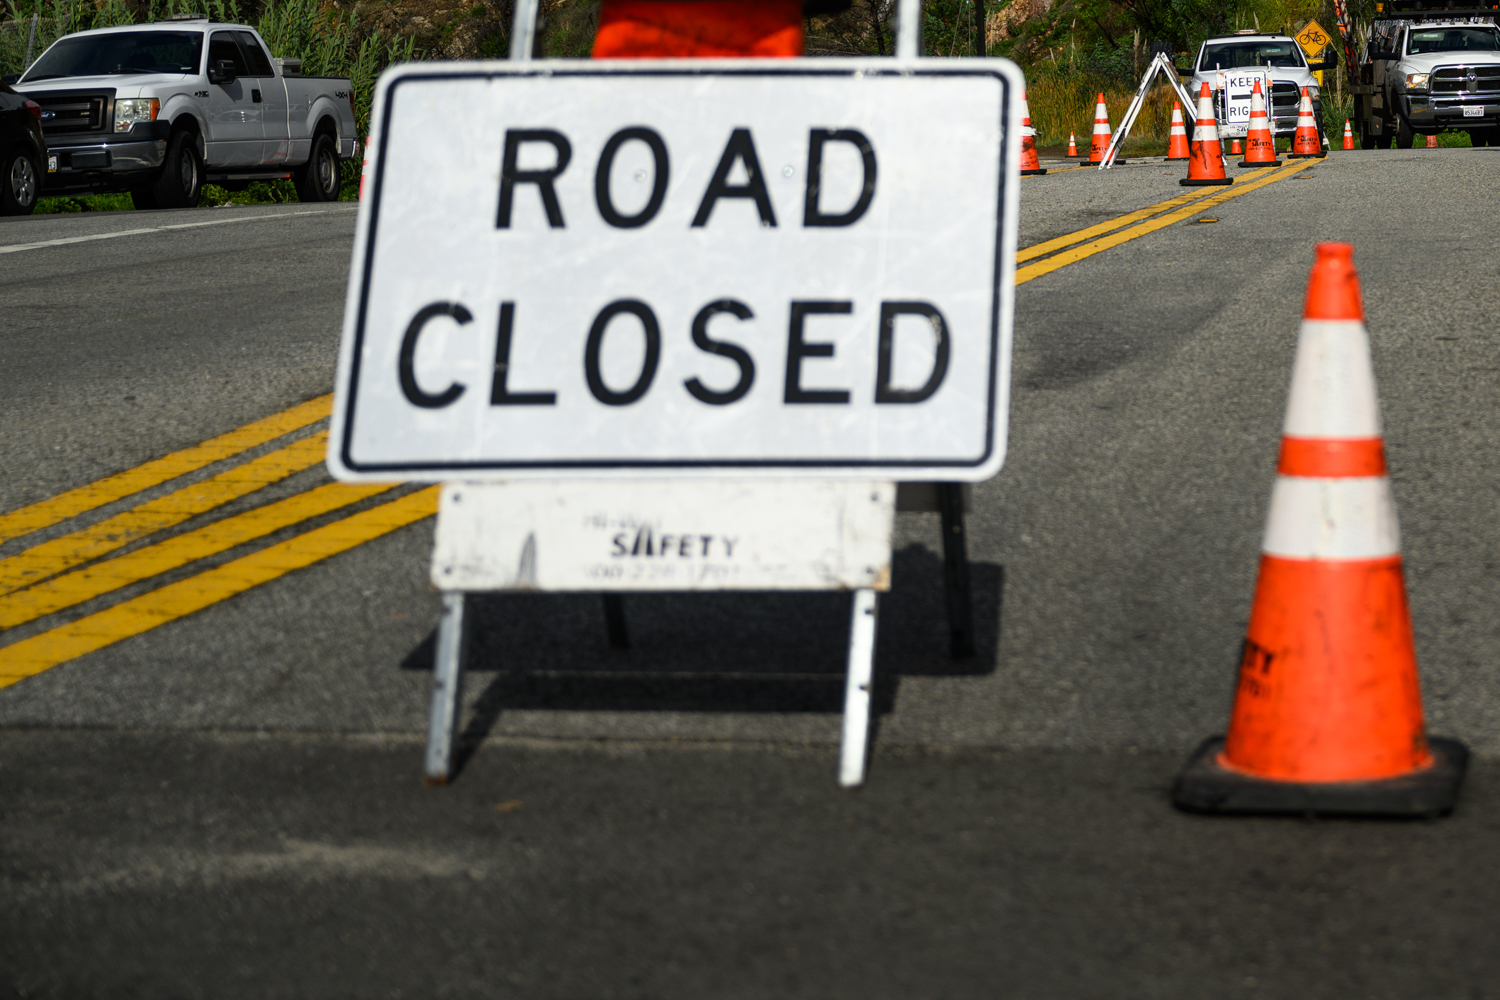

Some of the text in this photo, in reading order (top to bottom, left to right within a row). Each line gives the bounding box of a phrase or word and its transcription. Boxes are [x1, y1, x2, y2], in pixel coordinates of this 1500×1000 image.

[1229, 107, 1250, 117] RIG
[495, 125, 878, 230] ROAD
[397, 298, 951, 410] CLOSED
[610, 530, 739, 558] SAFETY
